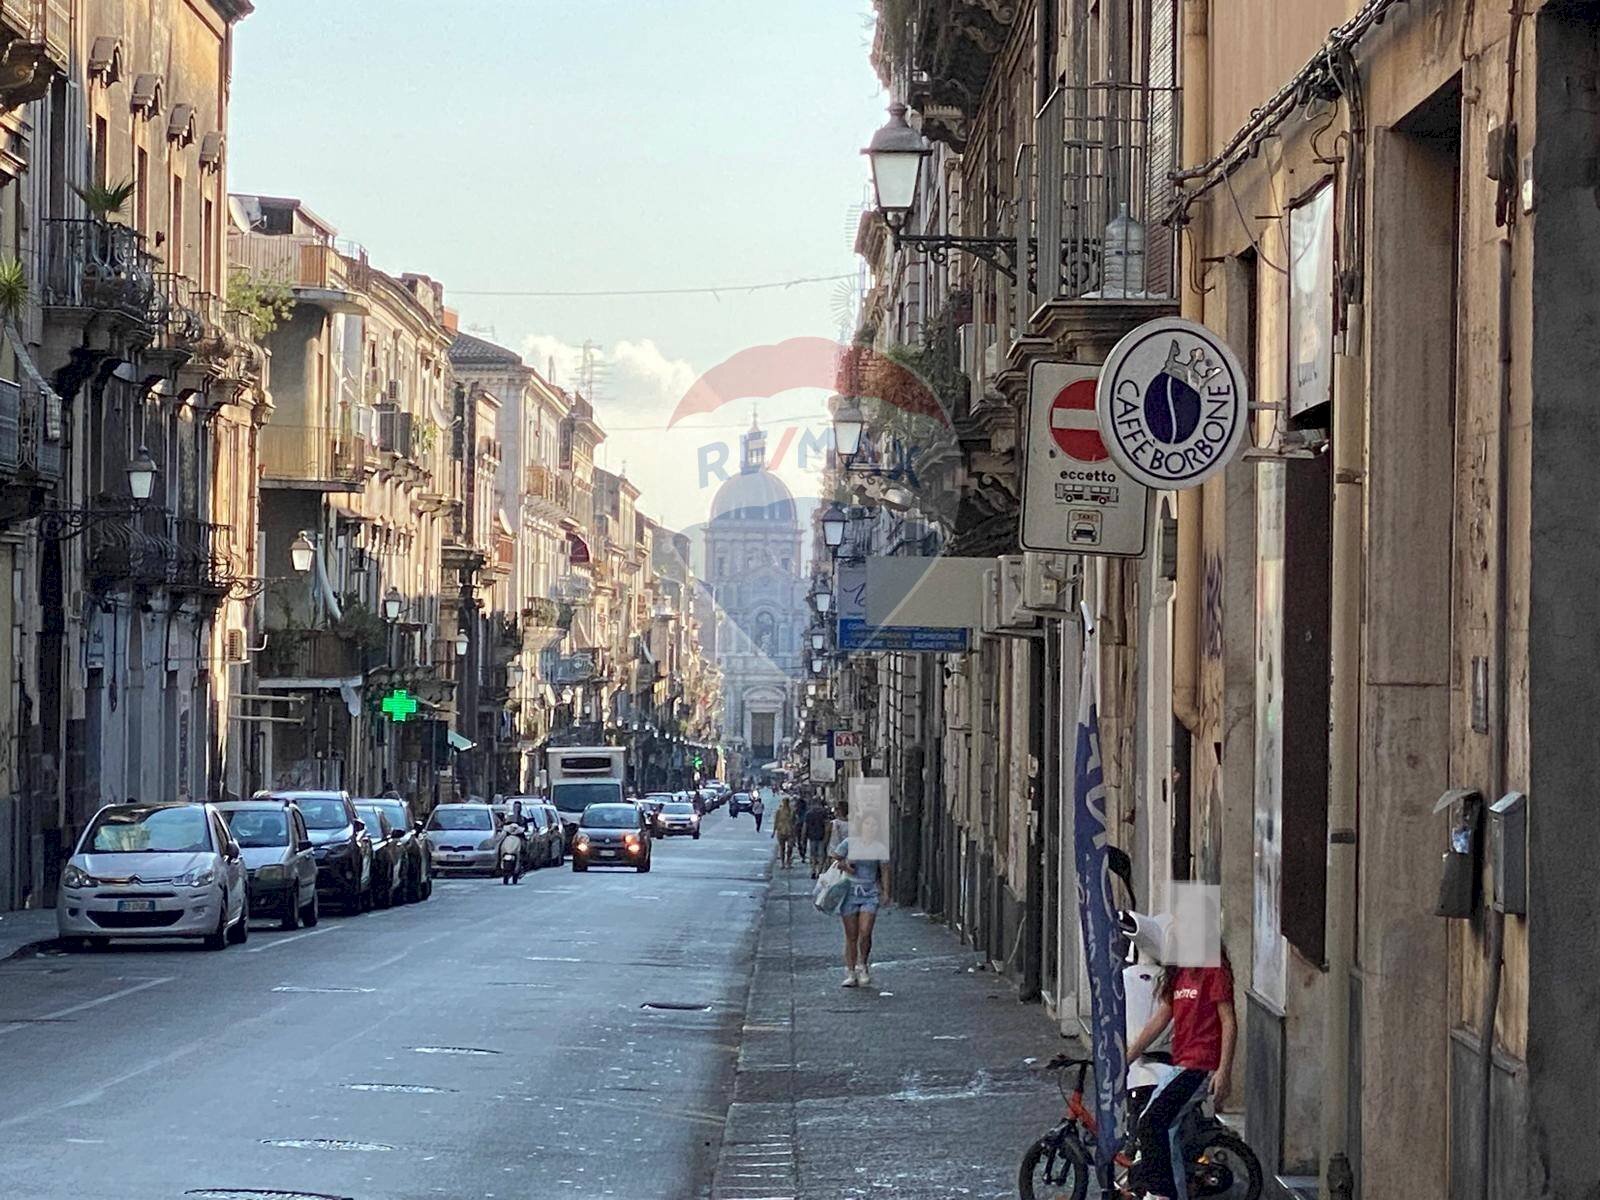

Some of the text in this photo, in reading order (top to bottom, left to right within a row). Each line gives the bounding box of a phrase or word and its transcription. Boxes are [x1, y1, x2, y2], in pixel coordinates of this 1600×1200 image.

[1116, 380, 1230, 474] CAFFÈ BORBONE
[1060, 470, 1116, 482] eccetto
